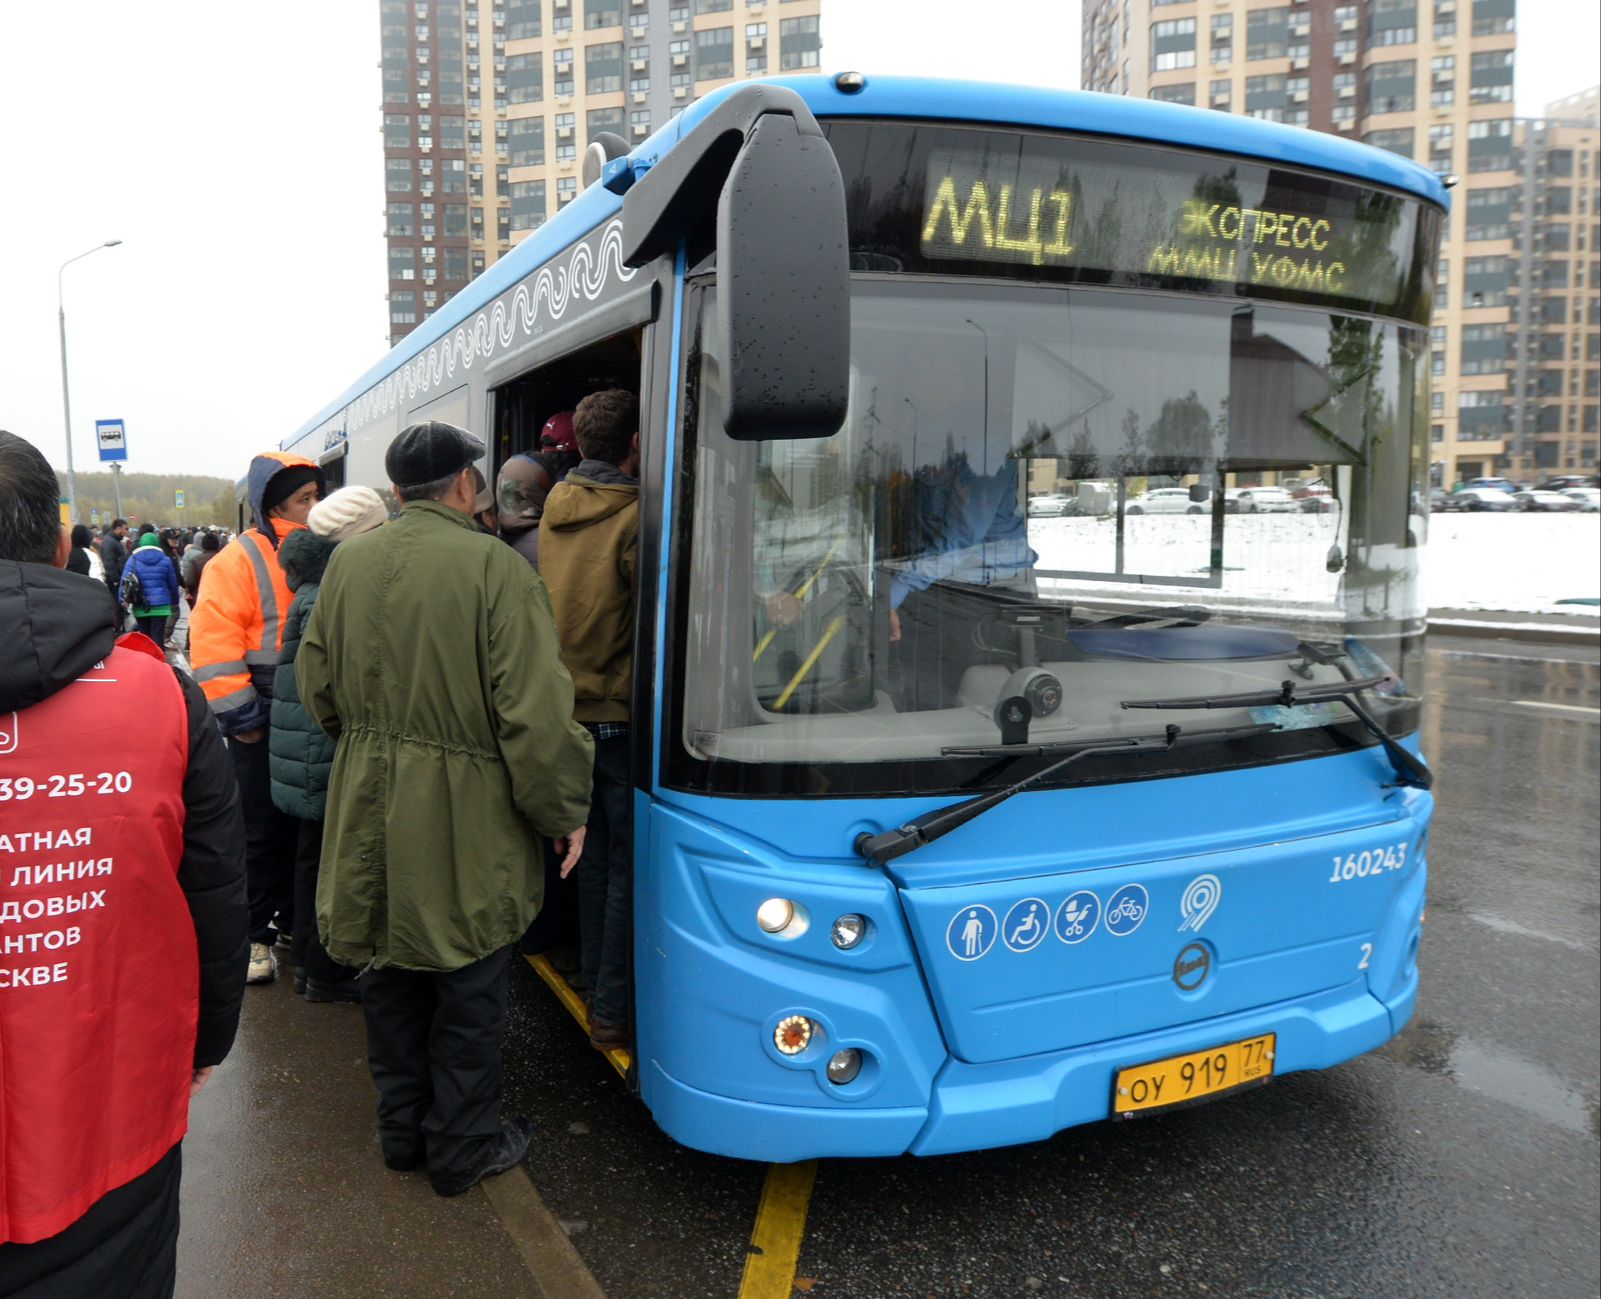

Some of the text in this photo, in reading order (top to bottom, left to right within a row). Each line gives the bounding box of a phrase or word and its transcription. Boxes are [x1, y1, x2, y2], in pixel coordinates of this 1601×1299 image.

[922, 176, 1075, 266] МЦ1
[1178, 200, 1332, 252] ЭКСПРЕСС
[1250, 251, 1347, 294] УФМС
[0, 771, 132, 801] 39-25-20
[0, 827, 92, 853] АТНАЯ
[10, 857, 114, 887] ЛИНИЯ
[1329, 842, 1408, 883] 160243
[0, 889, 106, 924] ДОВЫХ
[0, 926, 81, 954] НТОВ
[1357, 942, 1374, 969] 2
[1180, 1053, 1228, 1095] 919
[1243, 1040, 1265, 1068] 77
